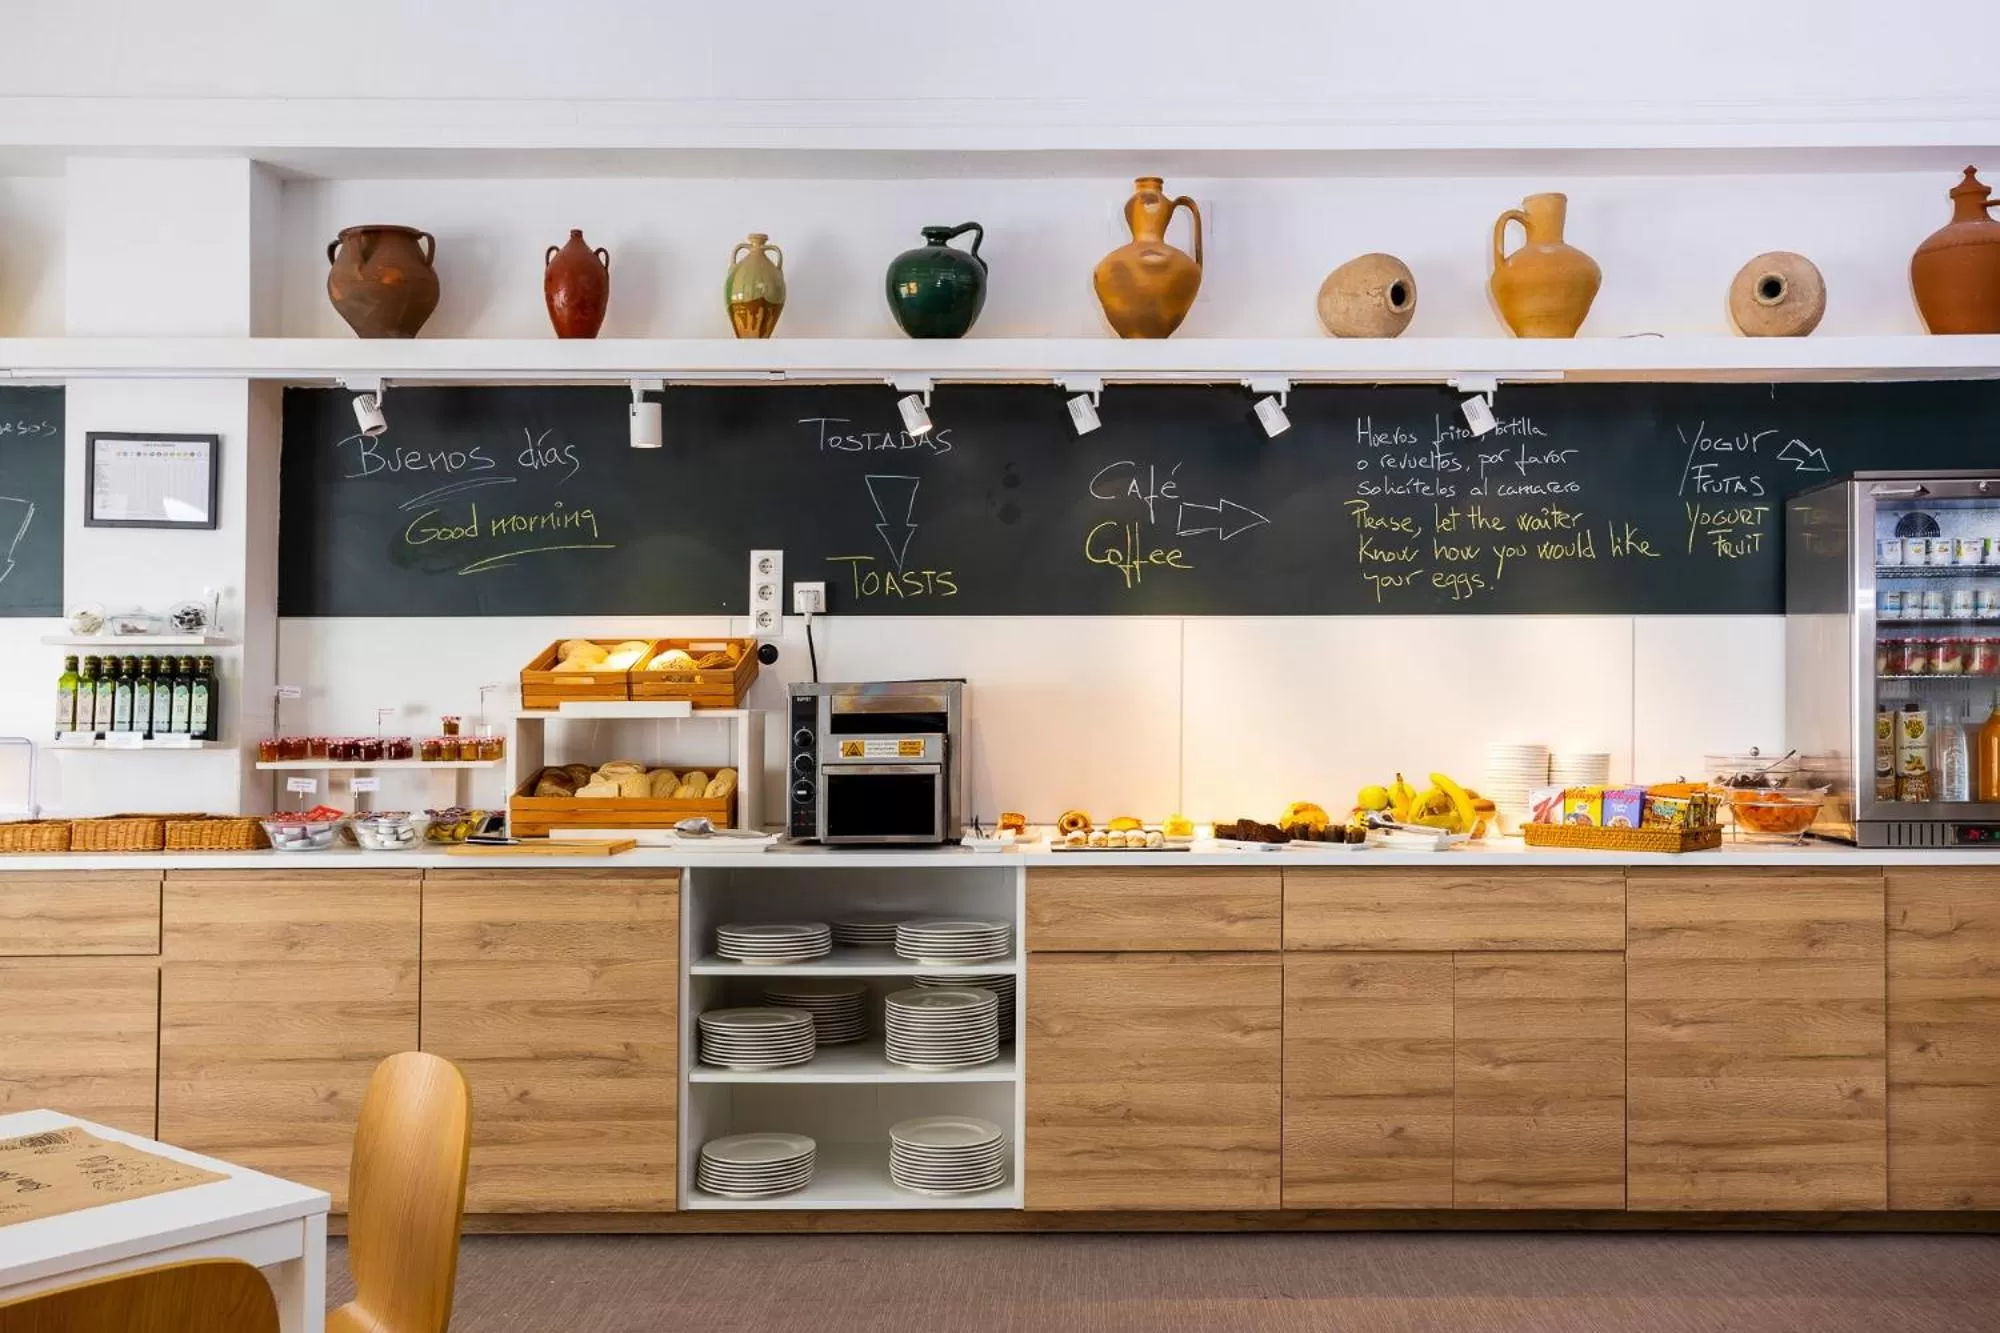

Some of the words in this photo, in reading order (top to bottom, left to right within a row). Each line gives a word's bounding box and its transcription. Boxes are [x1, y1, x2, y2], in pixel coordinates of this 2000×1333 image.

[1357, 416, 1418, 447] Huevos
[1432, 413, 1485, 455] frito,
[337, 432, 496, 478] Buenos
[518, 427, 581, 487] días
[1478, 449, 1511, 480] por
[1514, 443, 1579, 477] favor
[1470, 476, 1488, 497] al
[1496, 481, 1582, 496] camarero
[405, 502, 479, 545] Good
[491, 501, 599, 539] morning
[1344, 499, 1422, 540] Please,
[1468, 504, 1507, 531] the
[1516, 503, 1585, 530] waiter
[1686, 501, 1770, 555] YOGURT
[1085, 521, 1195, 589] Coffee
[1433, 537, 1481, 560] how
[1492, 545, 1528, 580] you
[1537, 529, 1596, 560] would
[825, 555, 958, 600] TOASTS
[1363, 569, 1424, 604] your
[1431, 572, 1495, 601] eggs.
